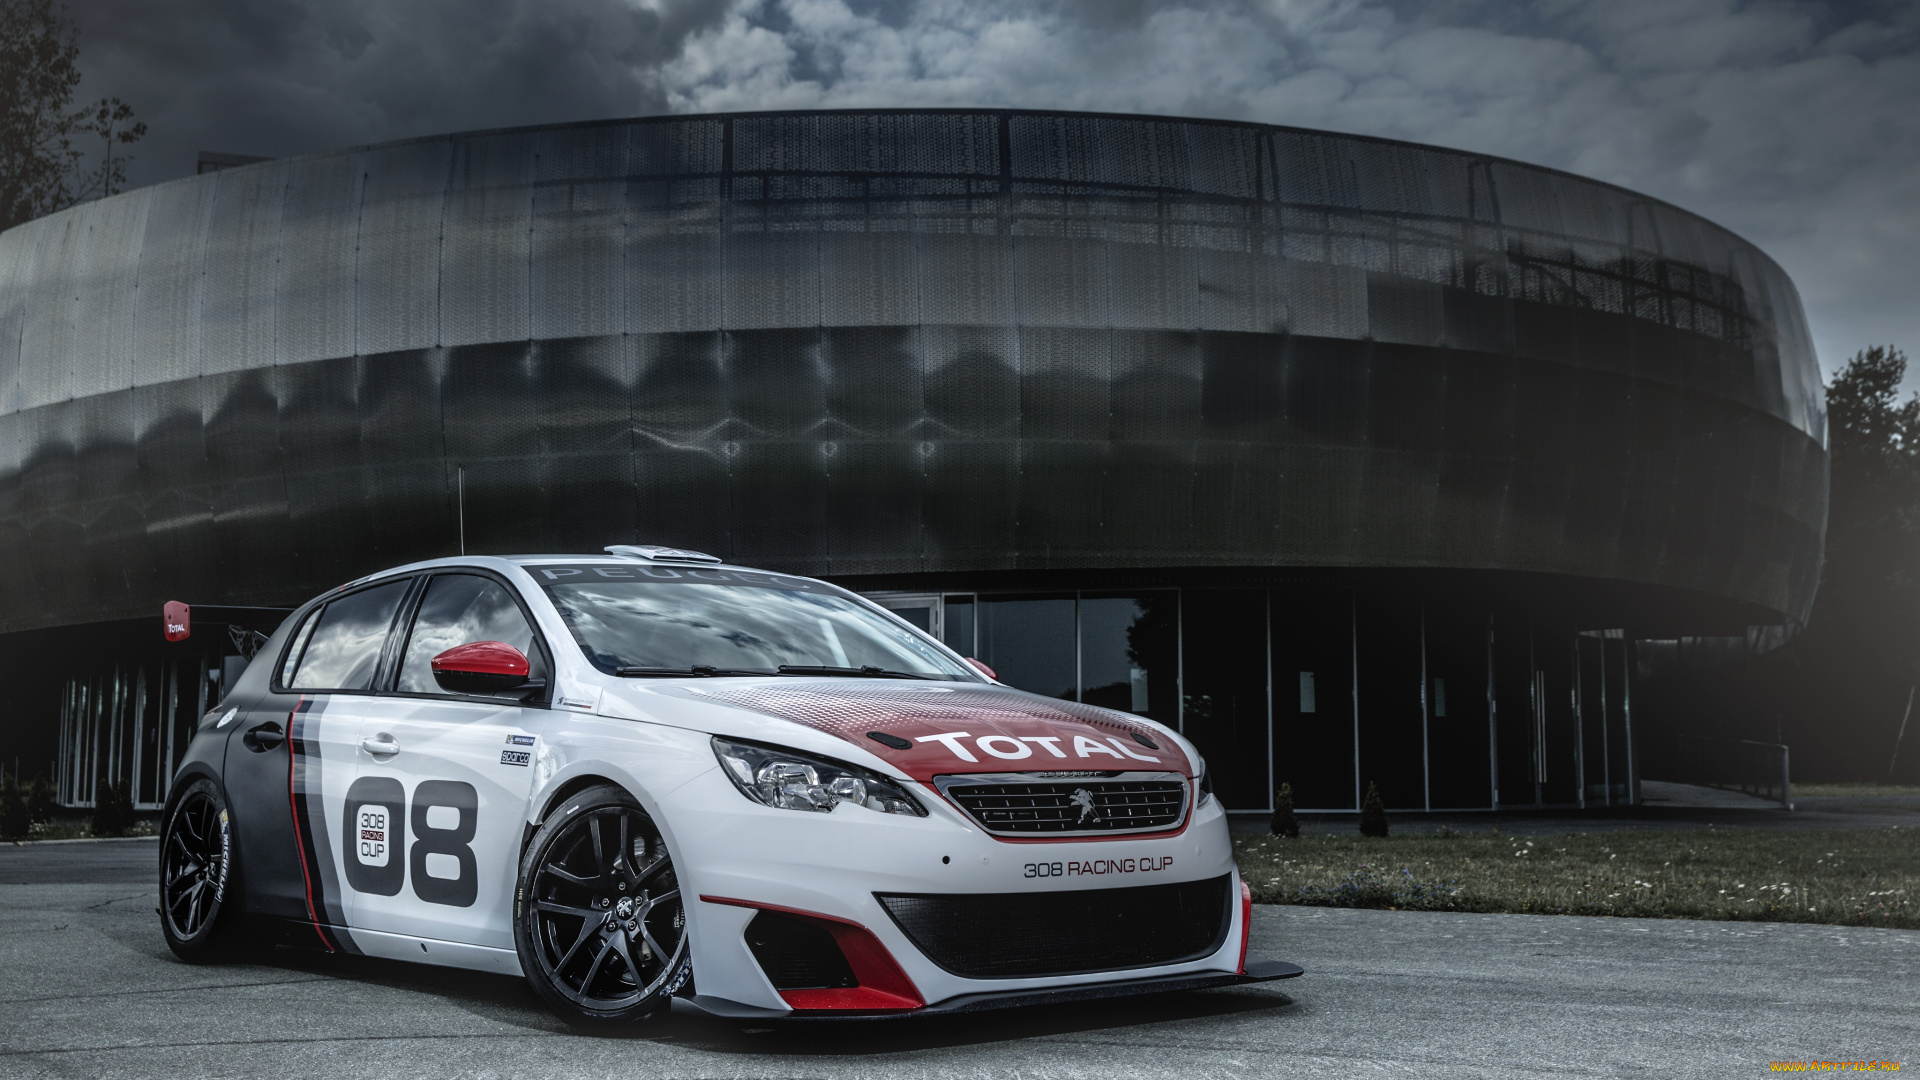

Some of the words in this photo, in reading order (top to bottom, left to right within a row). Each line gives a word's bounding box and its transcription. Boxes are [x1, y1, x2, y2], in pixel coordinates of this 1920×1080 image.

[168, 624, 185, 633] TOTAL
[914, 731, 1162, 764] TOTAL
[502, 751, 530, 763] sparco
[361, 813, 385, 829] 308
[342, 775, 479, 908] 08
[361, 831, 384, 841] RACING
[361, 842, 385, 858] CUP
[1024, 862, 1063, 878] 308
[1068, 858, 1136, 876] RACING
[1139, 856, 1174, 872] CUP
